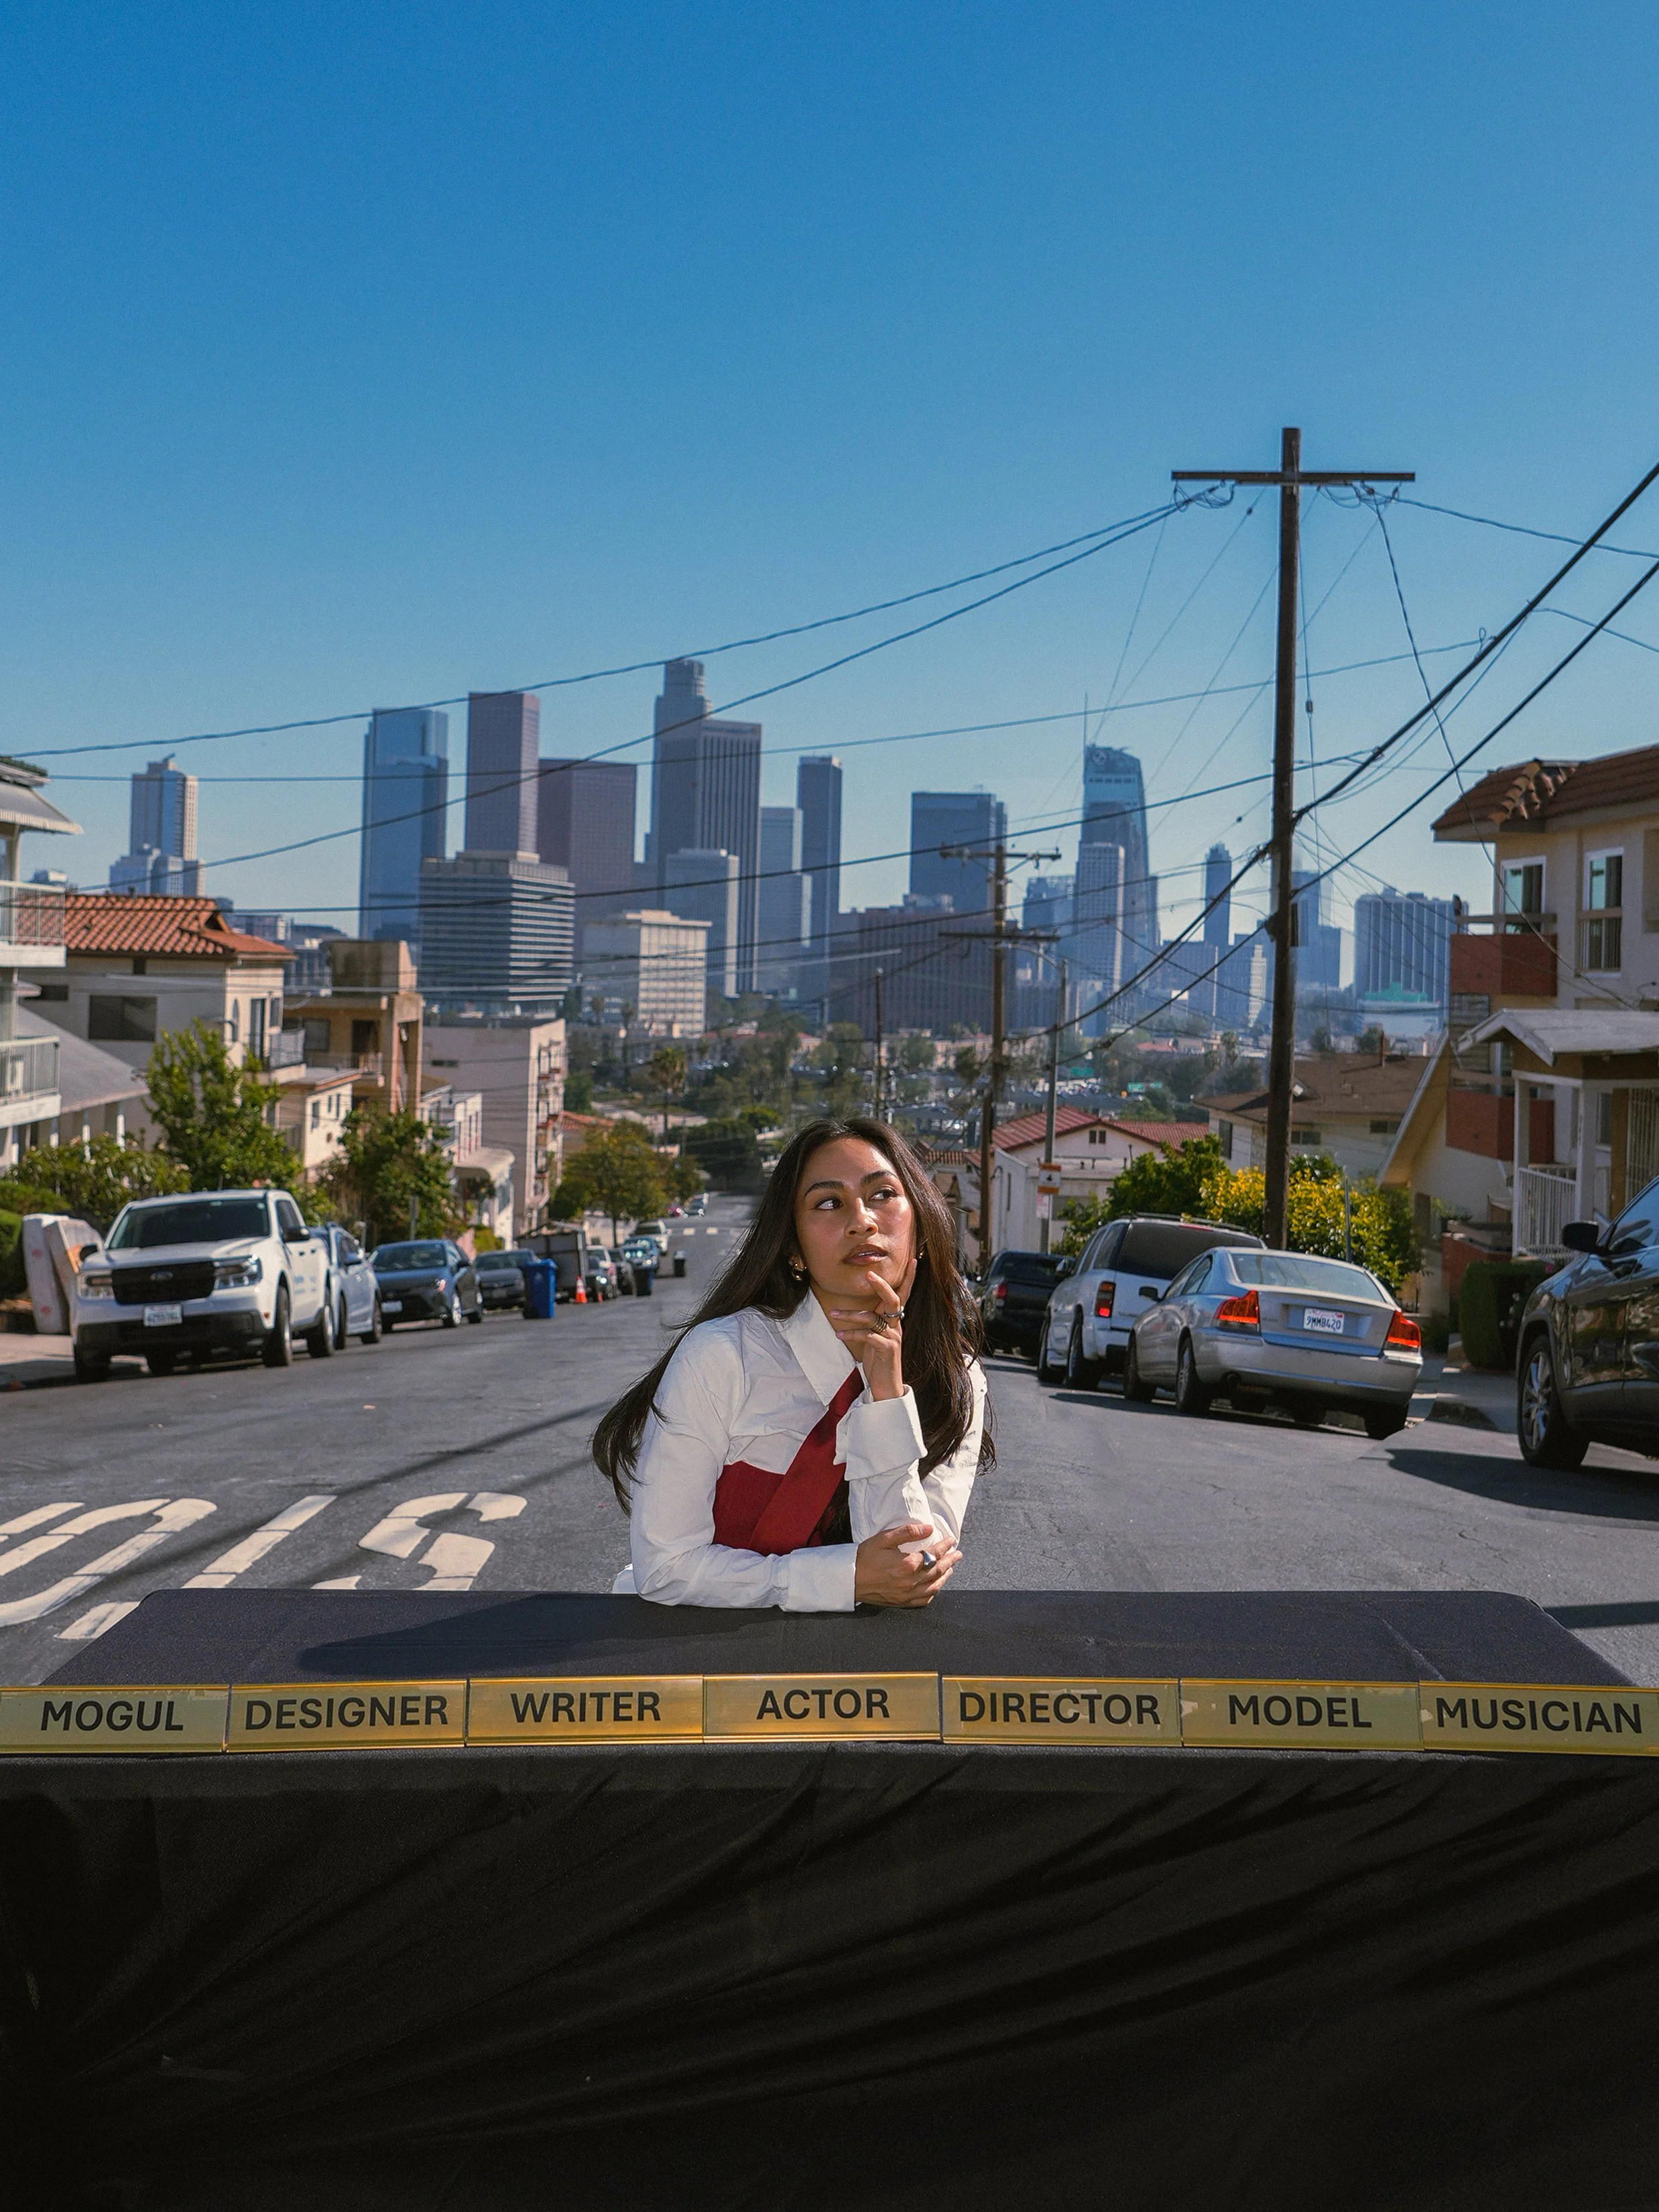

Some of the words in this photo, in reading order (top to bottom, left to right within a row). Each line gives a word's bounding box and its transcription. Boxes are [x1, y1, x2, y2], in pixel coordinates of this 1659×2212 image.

[0, 1491, 528, 1640] STO
[40, 1700, 184, 1731] MOGUL
[245, 1695, 448, 1731] DESIGNER
[510, 1691, 661, 1723] WRITER
[756, 1688, 890, 1720] ACTOR
[960, 1692, 1161, 1725] DIRECTOR
[1229, 1695, 1372, 1728] MODEL
[1436, 1697, 1642, 1734] MUSICIAN
